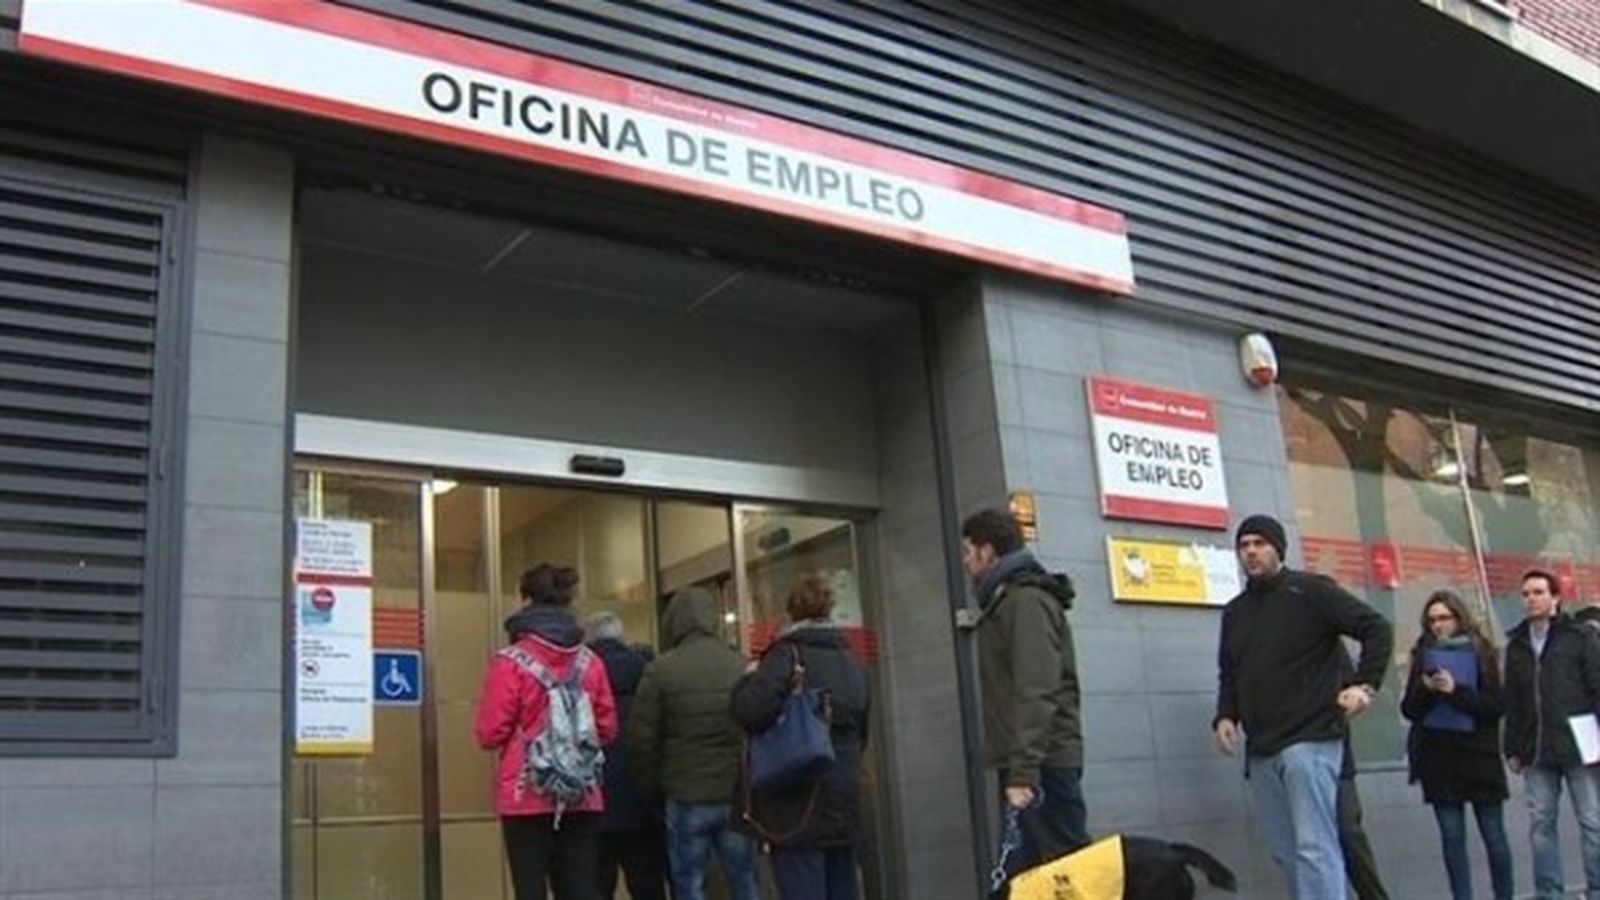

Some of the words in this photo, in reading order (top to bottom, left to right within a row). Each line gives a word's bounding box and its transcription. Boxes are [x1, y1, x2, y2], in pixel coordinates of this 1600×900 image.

[422, 72, 648, 158] OFICINA
[665, 128, 729, 178] DE
[746, 147, 924, 222] EMPLEO
[1108, 431, 1185, 462] OFICINA
[1187, 445, 1213, 467] DE
[1127, 461, 1204, 491] EMPLEO
